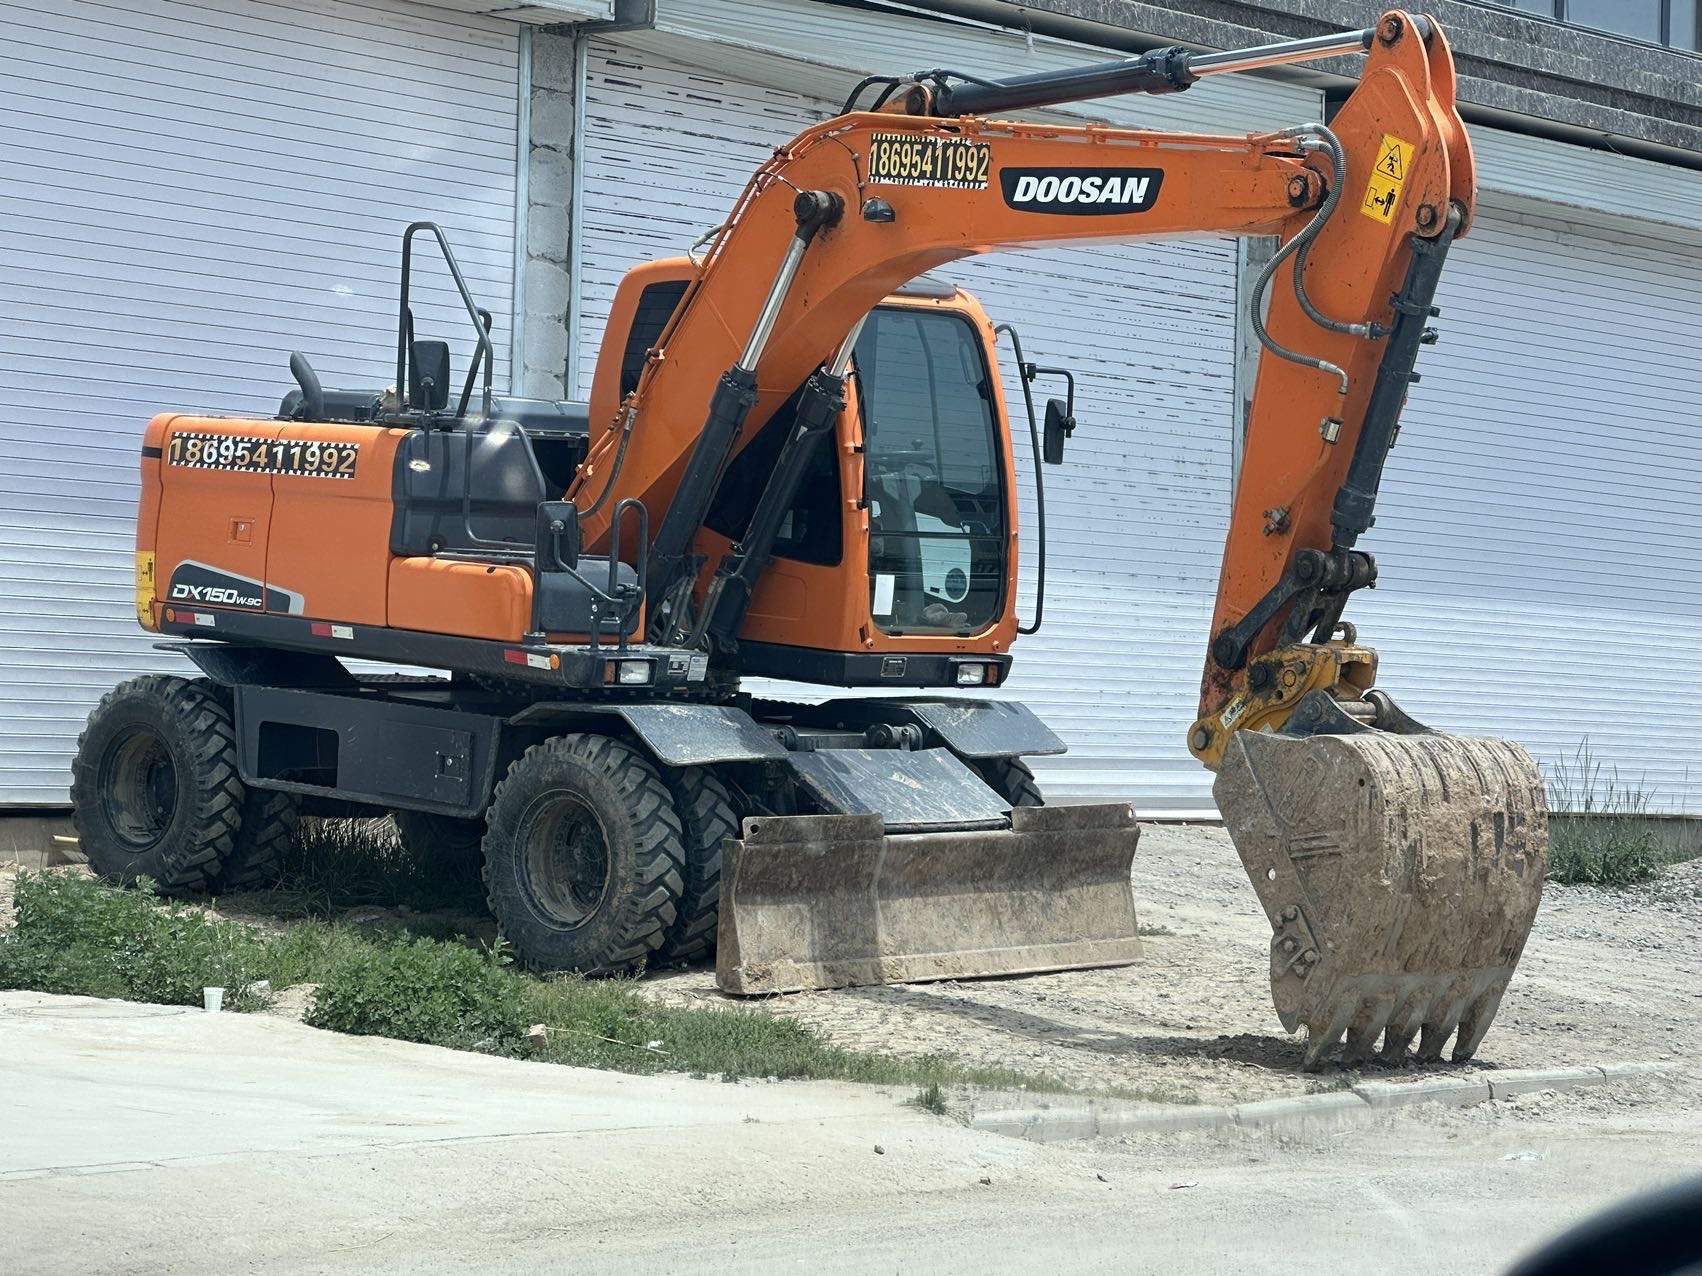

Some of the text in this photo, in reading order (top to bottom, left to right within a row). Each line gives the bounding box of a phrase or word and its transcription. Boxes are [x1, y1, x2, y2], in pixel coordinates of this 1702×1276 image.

[869, 142, 989, 181] 18695411992
[1013, 176, 1150, 203] DOOSAN
[169, 438, 357, 473] 18695411992
